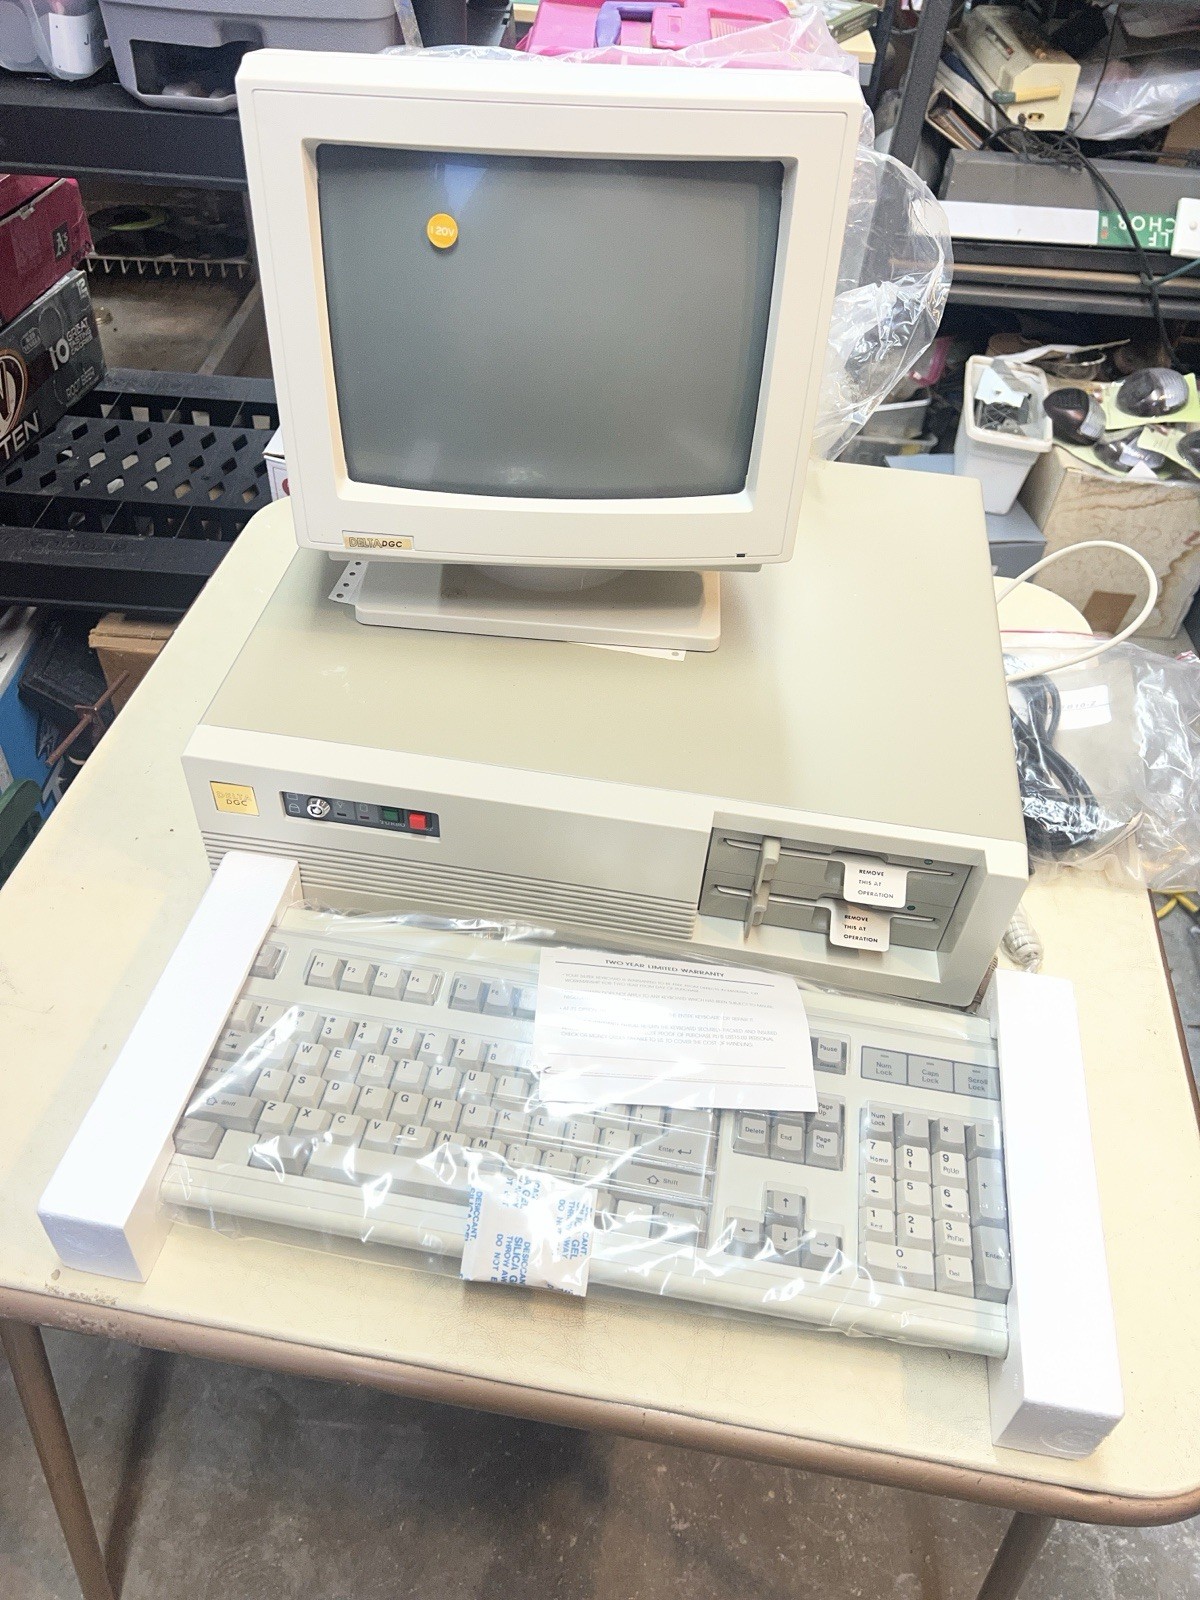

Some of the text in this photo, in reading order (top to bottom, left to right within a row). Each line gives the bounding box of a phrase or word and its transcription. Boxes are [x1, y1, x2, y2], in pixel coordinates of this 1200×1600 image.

[48, 338, 71, 371] 10
[381, 540, 403, 548] DGC
[226, 798, 248, 807] DGC
[858, 869, 885, 877] REMOVE
[857, 889, 894, 899] OPERATION
[844, 914, 869, 922] REMOVE
[843, 933, 879, 943] OPERATION
[315, 960, 325, 968] F1
[346, 966, 357, 974] F2
[625, 961, 645, 969] YEAR
[647, 963, 679, 972] LIMITED
[680, 967, 725, 978] WARRANTY
[378, 971, 388, 979] F3
[325, 1027, 332, 1035] 3
[391, 1037, 398, 1045] 5
[424, 1042, 431, 1050] 6
[458, 1048, 464, 1056] 7
[819, 1043, 838, 1053] Pause
[301, 1044, 313, 1054] W
[333, 1049, 343, 1059] E
[367, 1055, 376, 1064] R
[402, 1060, 410, 1069] T
[435, 1066, 443, 1076] Y
[468, 1072, 477, 1081] U
[876, 1061, 892, 1069] Num
[875, 1068, 893, 1077] Lock
[921, 1068, 940, 1078] Caps
[921, 1076, 940, 1085] Lock
[967, 1076, 988, 1085] Scroll
[967, 1084, 986, 1092] Lock
[263, 1070, 272, 1079] A
[297, 1076, 307, 1084] S
[331, 1082, 340, 1091] D
[365, 1087, 374, 1096] F
[400, 1093, 410, 1103] G
[433, 1100, 443, 1109] H
[468, 1106, 476, 1115] J
[503, 1112, 512, 1121] K
[818, 1102, 834, 1111] Page
[818, 1109, 827, 1117] Up
[870, 1111, 886, 1119] Num
[267, 1102, 277, 1111] Z
[302, 1108, 312, 1118] X
[337, 1115, 347, 1124] C
[373, 1121, 381, 1130] V
[407, 1127, 416, 1136] B
[442, 1133, 452, 1142] N
[478, 1139, 488, 1148] M
[745, 1126, 765, 1135] Delete
[780, 1133, 793, 1141] End
[815, 1135, 832, 1144] Page
[658, 1145, 675, 1154] Enter
[869, 1141, 876, 1150] 7
[906, 1148, 914, 1157] 8
[942, 1153, 950, 1163] 9
[662, 1177, 679, 1186] Shift
[869, 1176, 877, 1184] 4
[906, 1181, 914, 1190] 5
[943, 1188, 951, 1198] 6
[470, 1190, 484, 1241] DESICCANT.
[871, 1209, 876, 1218] 1
[907, 1215, 915, 1225] 2
[945, 1222, 953, 1231] 3
[495, 1233, 504, 1247] DO
[503, 1235, 514, 1268] THROW
[561, 1236, 572, 1259] WAY
[569, 1239, 580, 1260] GEL
[511, 1236, 524, 1271] SILICA
[895, 1248, 904, 1258] 0
[492, 1252, 502, 1271] NOT
